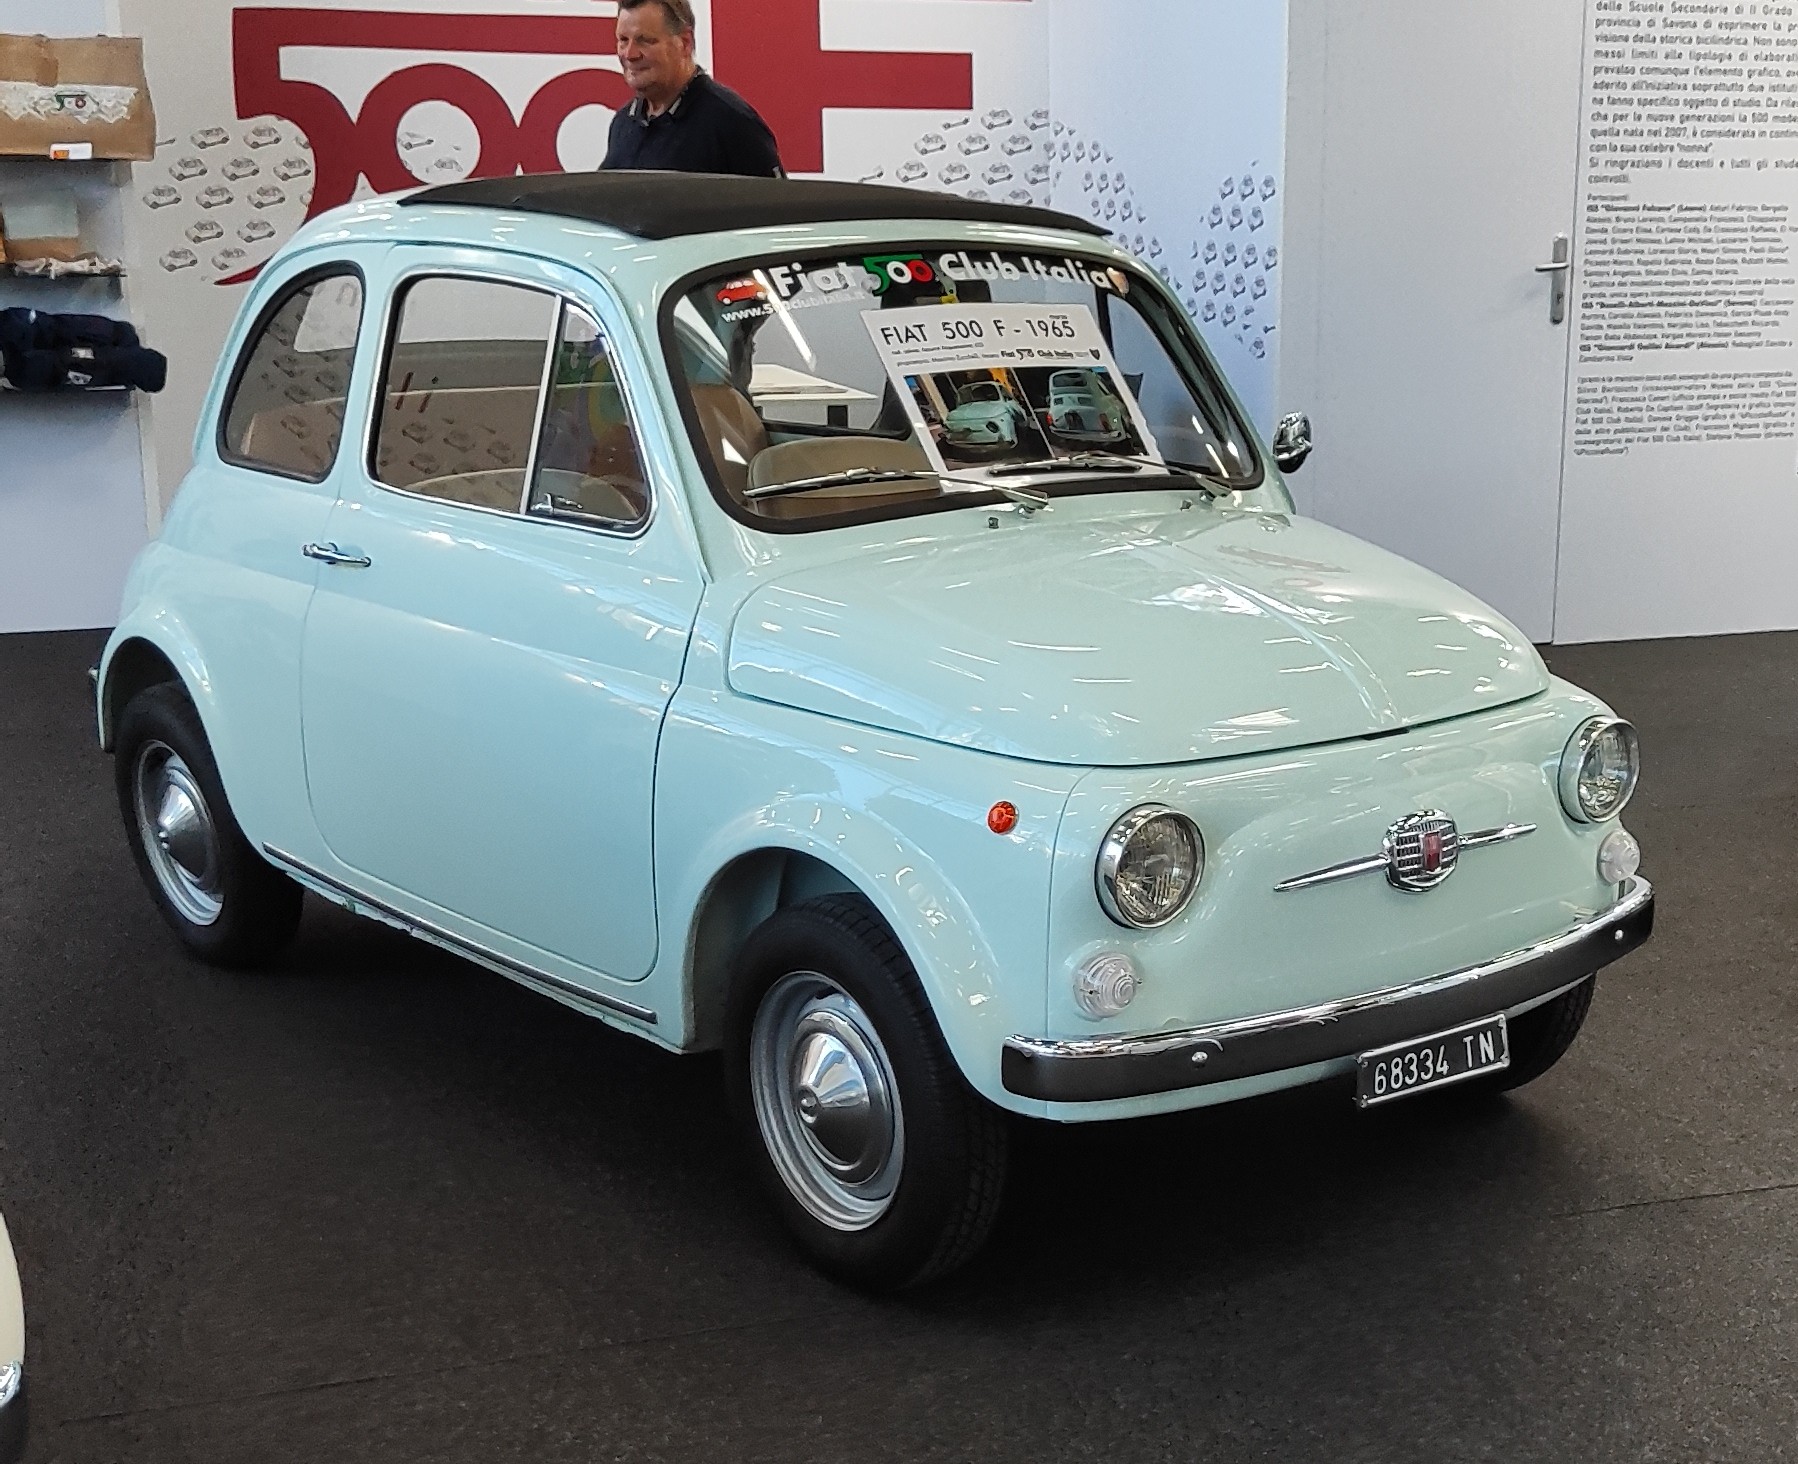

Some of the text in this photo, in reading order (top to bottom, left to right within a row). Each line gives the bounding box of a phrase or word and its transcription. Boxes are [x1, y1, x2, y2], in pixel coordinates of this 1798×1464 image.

[768, 251, 1113, 297] Fiat 500 Club Italia
[881, 323, 929, 346] FIAT
[941, 319, 984, 340] 500
[993, 319, 1006, 337] F
[1025, 319, 1076, 339] 1965
[1373, 1030, 1495, 1095] 68334 TN
